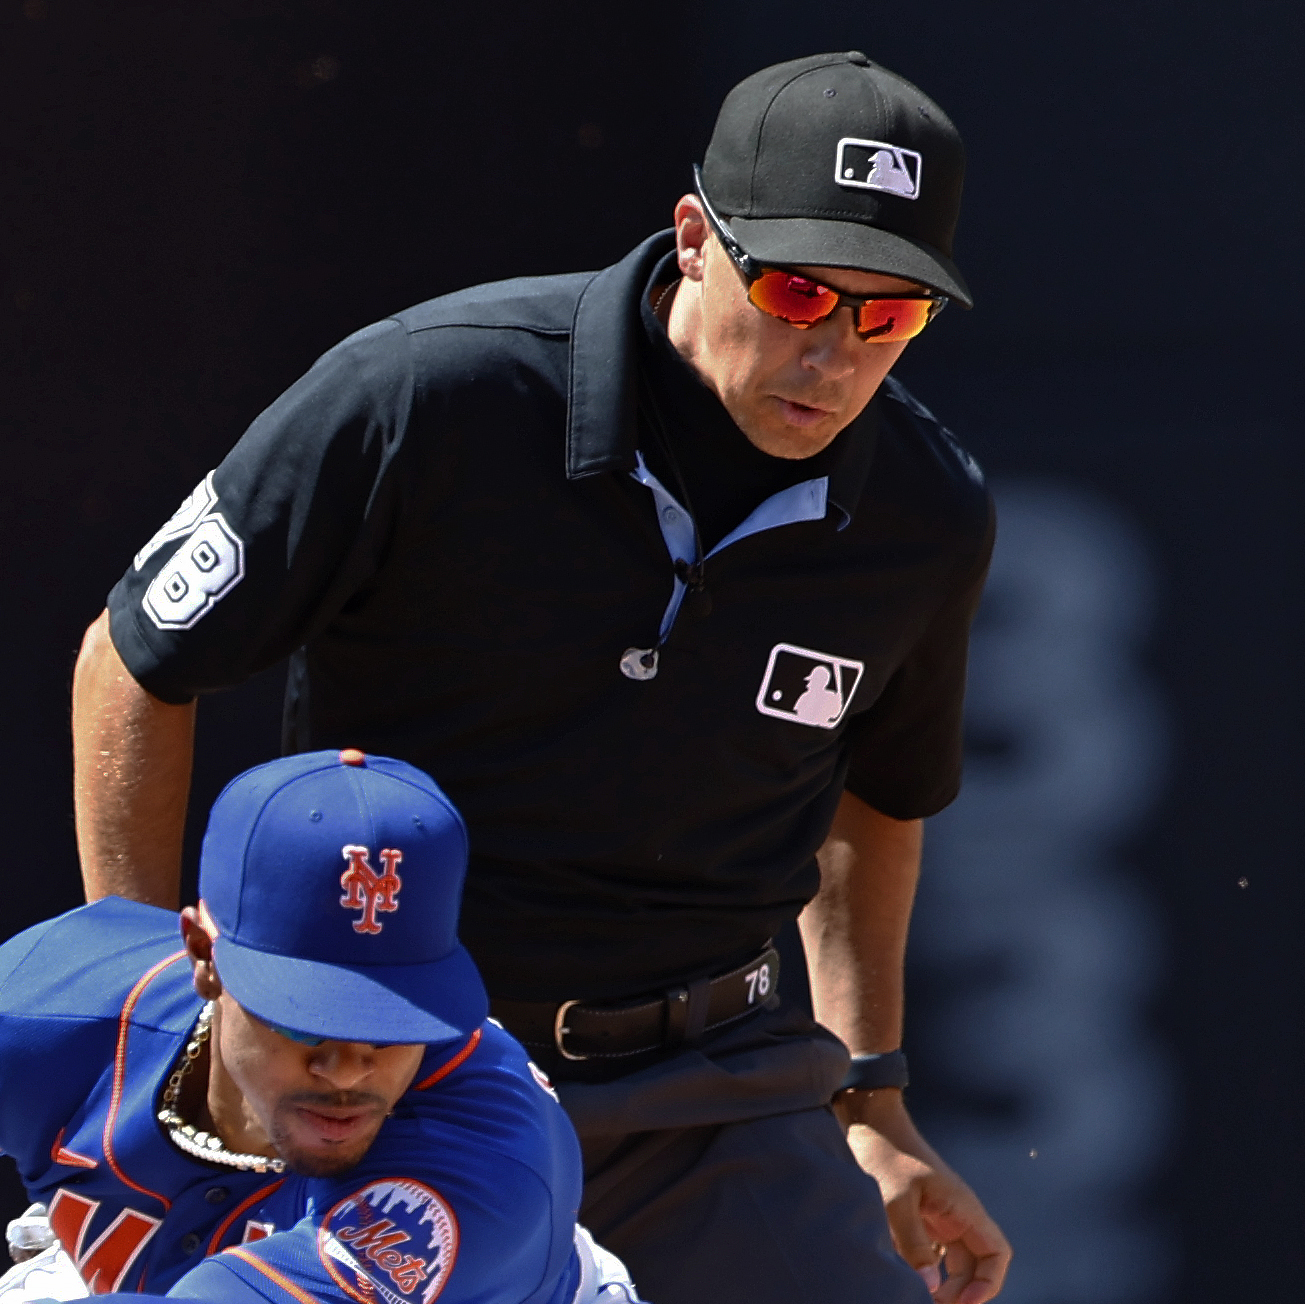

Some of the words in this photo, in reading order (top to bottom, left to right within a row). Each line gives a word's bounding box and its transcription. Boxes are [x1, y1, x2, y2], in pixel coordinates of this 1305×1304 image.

[340, 844, 403, 935] NY
[744, 963, 771, 1005] 78
[336, 1218, 428, 1295] Mets
